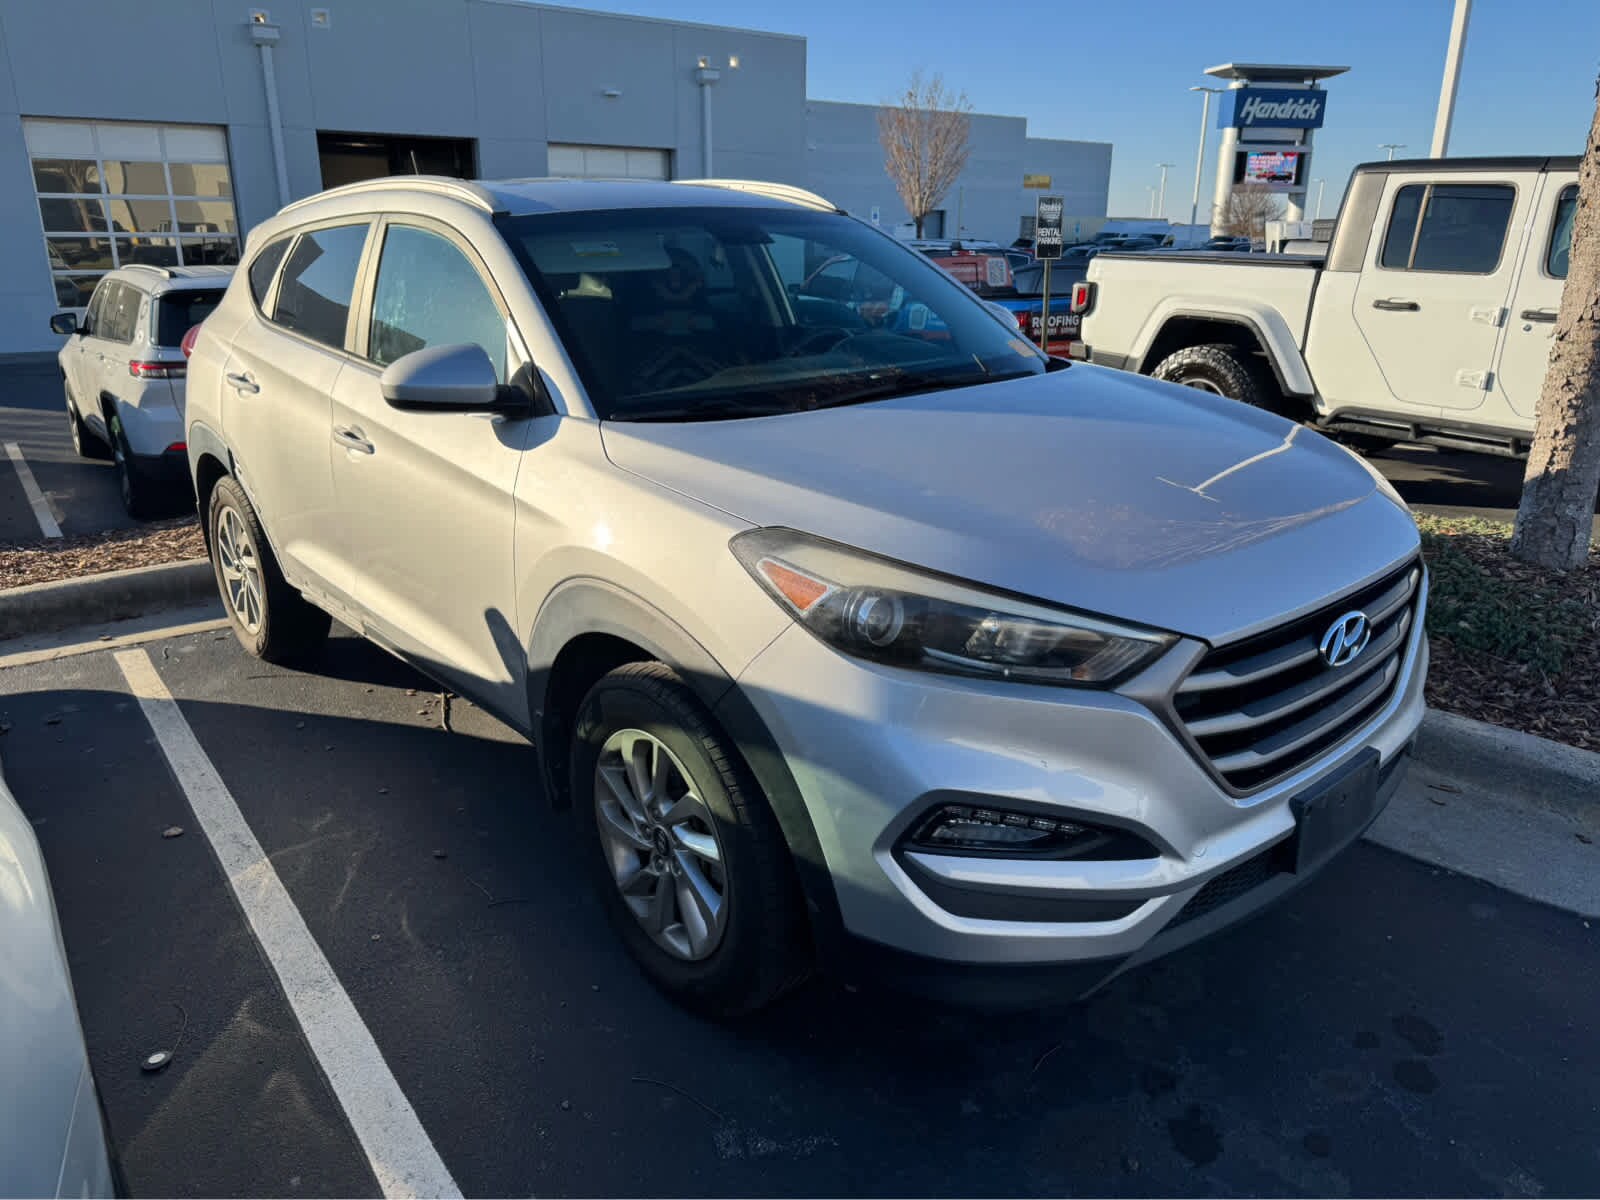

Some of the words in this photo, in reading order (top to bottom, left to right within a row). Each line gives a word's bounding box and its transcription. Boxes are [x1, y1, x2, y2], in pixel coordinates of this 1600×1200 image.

[1240, 97, 1320, 125] Hendrick
[1038, 227, 1062, 237] RENTAL
[1037, 237, 1062, 245] PARKING
